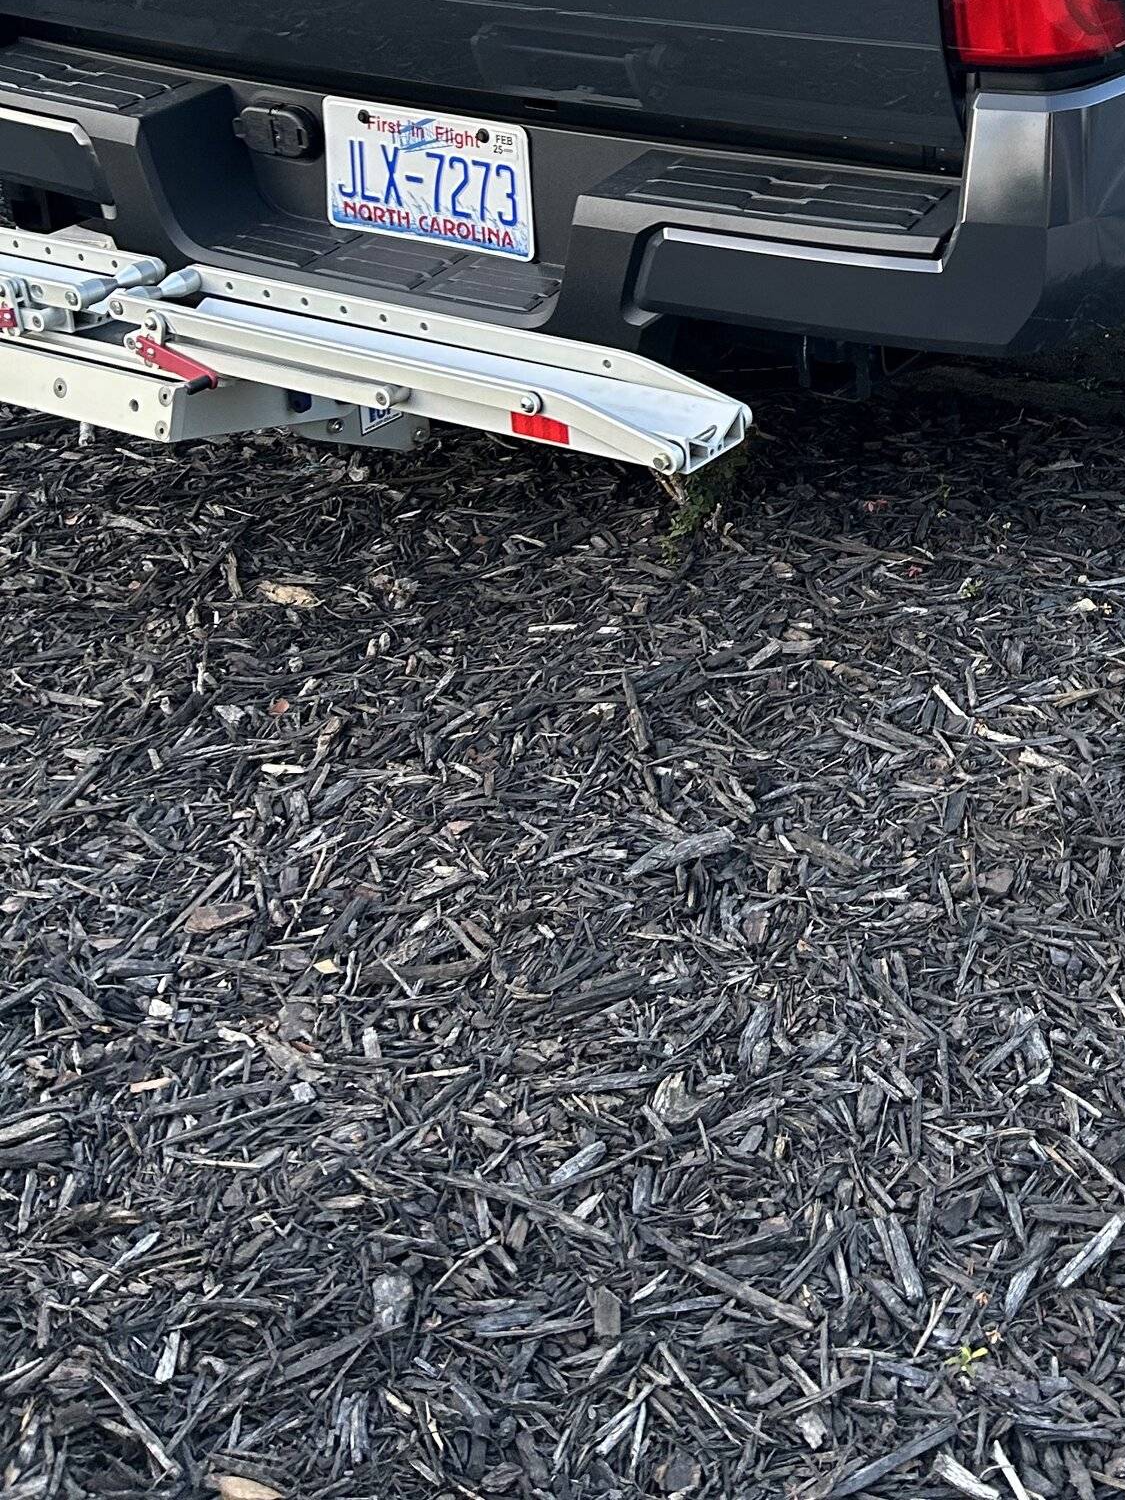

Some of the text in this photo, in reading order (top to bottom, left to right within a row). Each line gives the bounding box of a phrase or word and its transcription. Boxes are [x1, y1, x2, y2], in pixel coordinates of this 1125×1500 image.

[366, 115, 480, 149] First in Flight
[495, 134, 513, 146] FEB
[493, 144, 504, 155] 25
[338, 139, 518, 227] JLX-7273
[343, 201, 515, 250] NORTH CAROLINA
